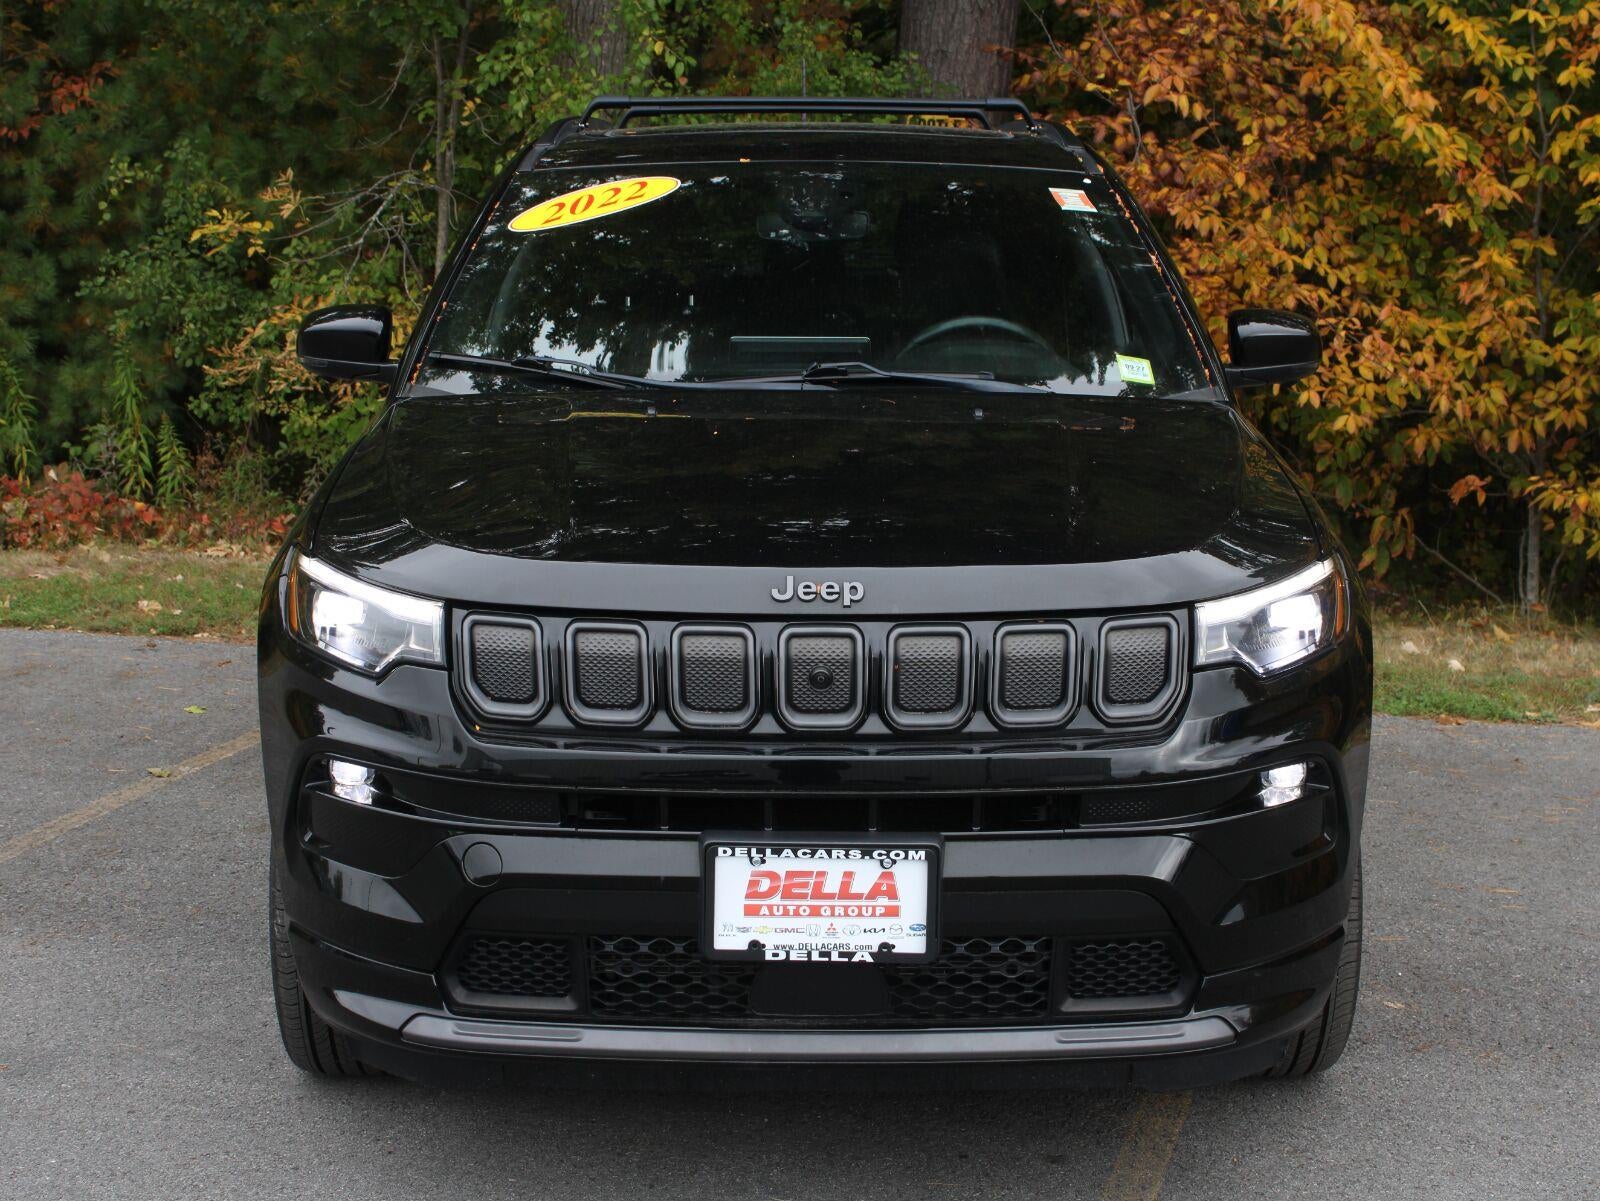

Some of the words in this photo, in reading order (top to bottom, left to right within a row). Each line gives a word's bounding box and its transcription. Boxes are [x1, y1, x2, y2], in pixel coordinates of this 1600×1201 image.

[541, 181, 648, 225] 2022
[771, 575, 864, 608] Jeep
[717, 847, 926, 860] DELLACARS.COM
[744, 870, 900, 902] DELLA
[760, 905, 811, 916] AUTO
[820, 906, 886, 917] GROUP
[773, 943, 873, 951] www.DELLACARS.com
[765, 950, 875, 962] DELLA
